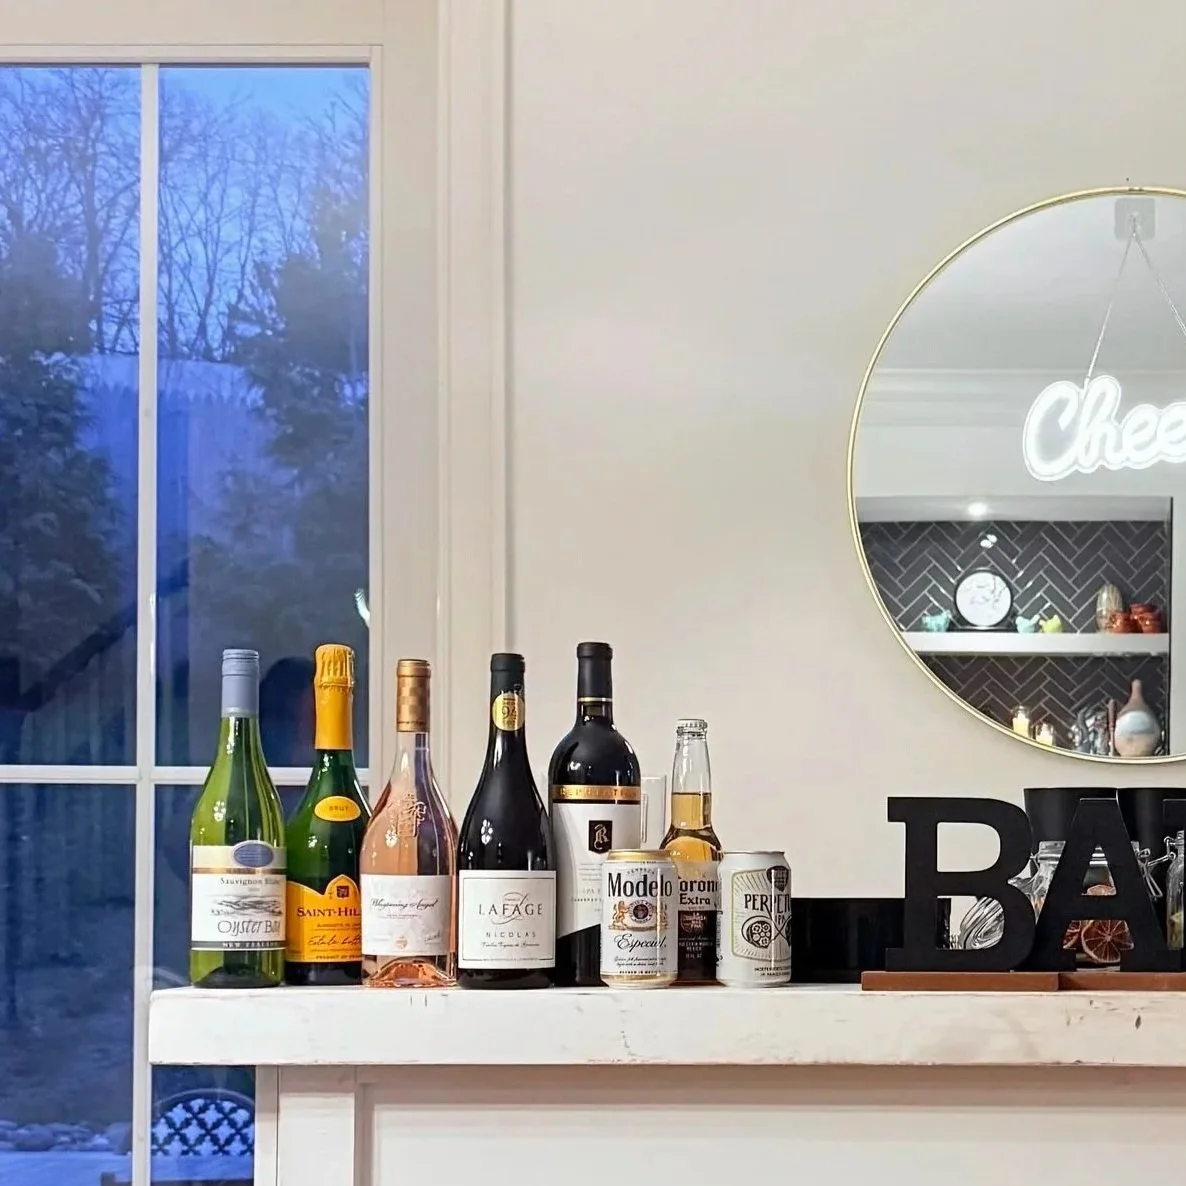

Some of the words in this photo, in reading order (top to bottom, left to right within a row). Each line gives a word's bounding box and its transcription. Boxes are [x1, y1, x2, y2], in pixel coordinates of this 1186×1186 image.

[608, 872, 672, 898] Modelo
[679, 879, 718, 893] oron
[679, 893, 711, 905] Extra
[478, 903, 543, 915] LAFAGE
